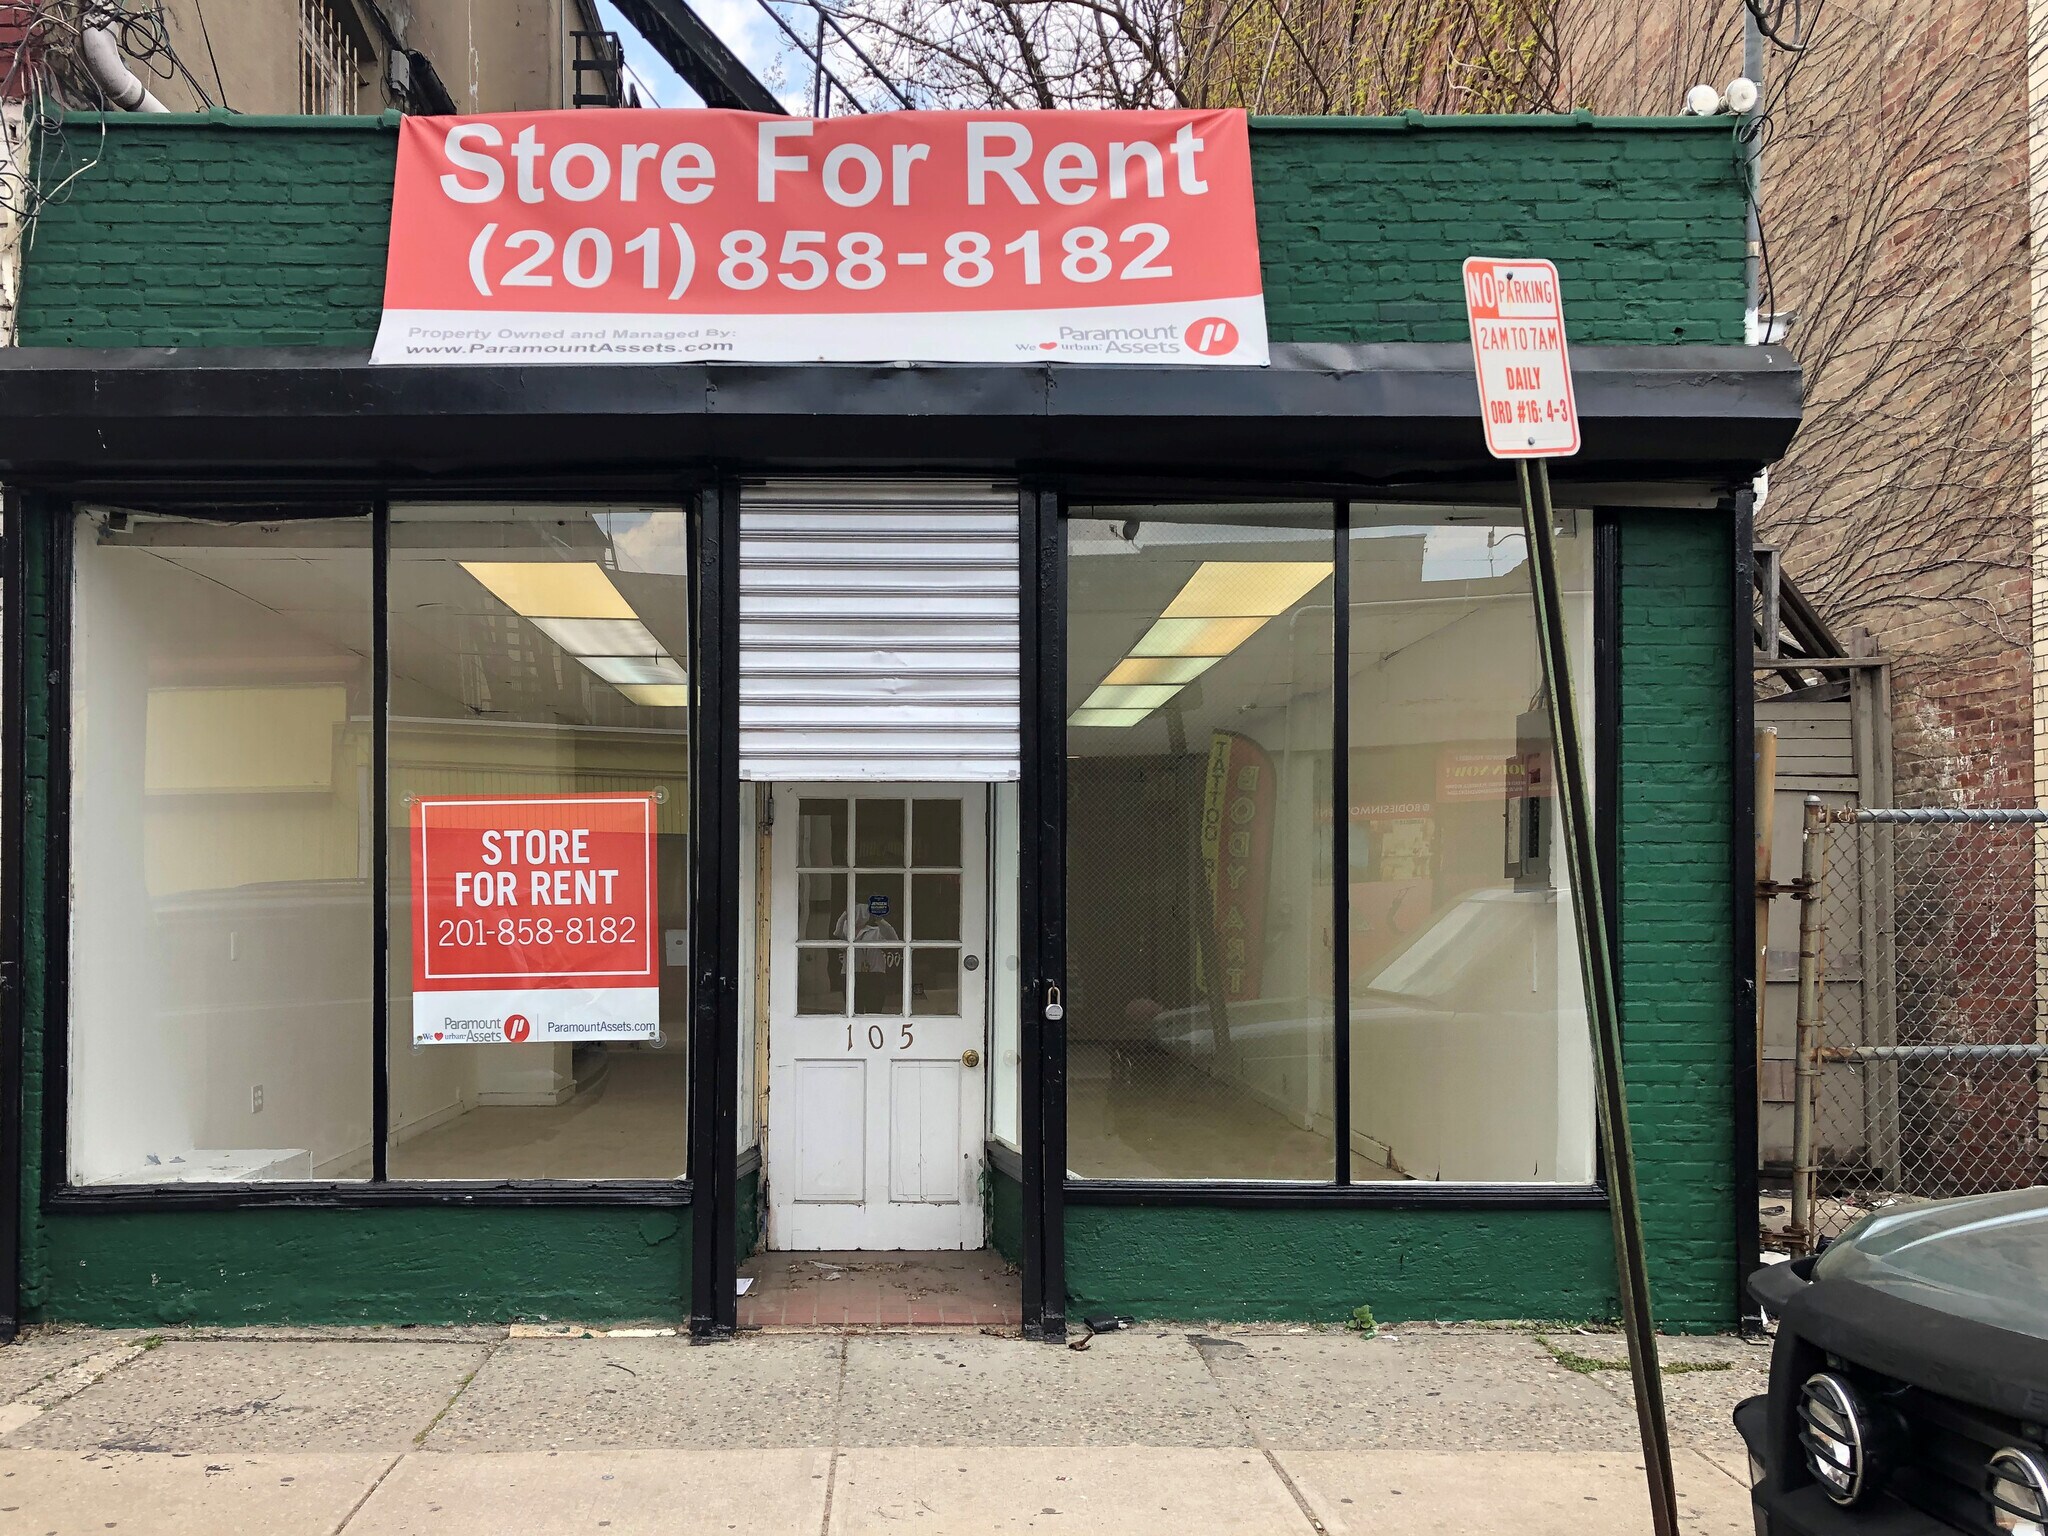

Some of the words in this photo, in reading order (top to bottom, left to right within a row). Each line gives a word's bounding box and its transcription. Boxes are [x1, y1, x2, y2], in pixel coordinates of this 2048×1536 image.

[439, 122, 716, 205] Store
[757, 121, 931, 208] For
[966, 121, 1209, 206] Rent
[468, 222, 696, 300] (201)
[717, 222, 1173, 291] 858-8182
[1468, 271, 1496, 309] NO
[1498, 280, 1553, 304] PARKING
[408, 327, 492, 341] Property
[497, 328, 565, 339] Owned
[570, 329, 606, 339] and
[612, 329, 699, 340] Managed
[705, 328, 737, 339] By:
[1058, 323, 1179, 341] Paramount
[1480, 327, 1510, 350] 2AM
[1511, 327, 1528, 350] TO
[1529, 327, 1559, 350] 7AM
[406, 343, 734, 354] www.ParamountAssets.com
[1015, 343, 1036, 351] We
[1105, 340, 1181, 354] Assets
[1505, 367, 1541, 390] DAILY
[1490, 400, 1513, 424] ORD
[1517, 400, 1543, 424] #16:
[1547, 399, 1568, 422] 4-3
[481, 829, 590, 866] STORE
[455, 871, 518, 907] FOR
[530, 869, 619, 906] RENT
[438, 916, 636, 947] 201-858-8182
[444, 1017, 501, 1030] Paramount
[547, 1021, 656, 1033] ParamountAssets.com
[465, 1029, 501, 1042] Assets
[847, 1023, 914, 1051] 105
